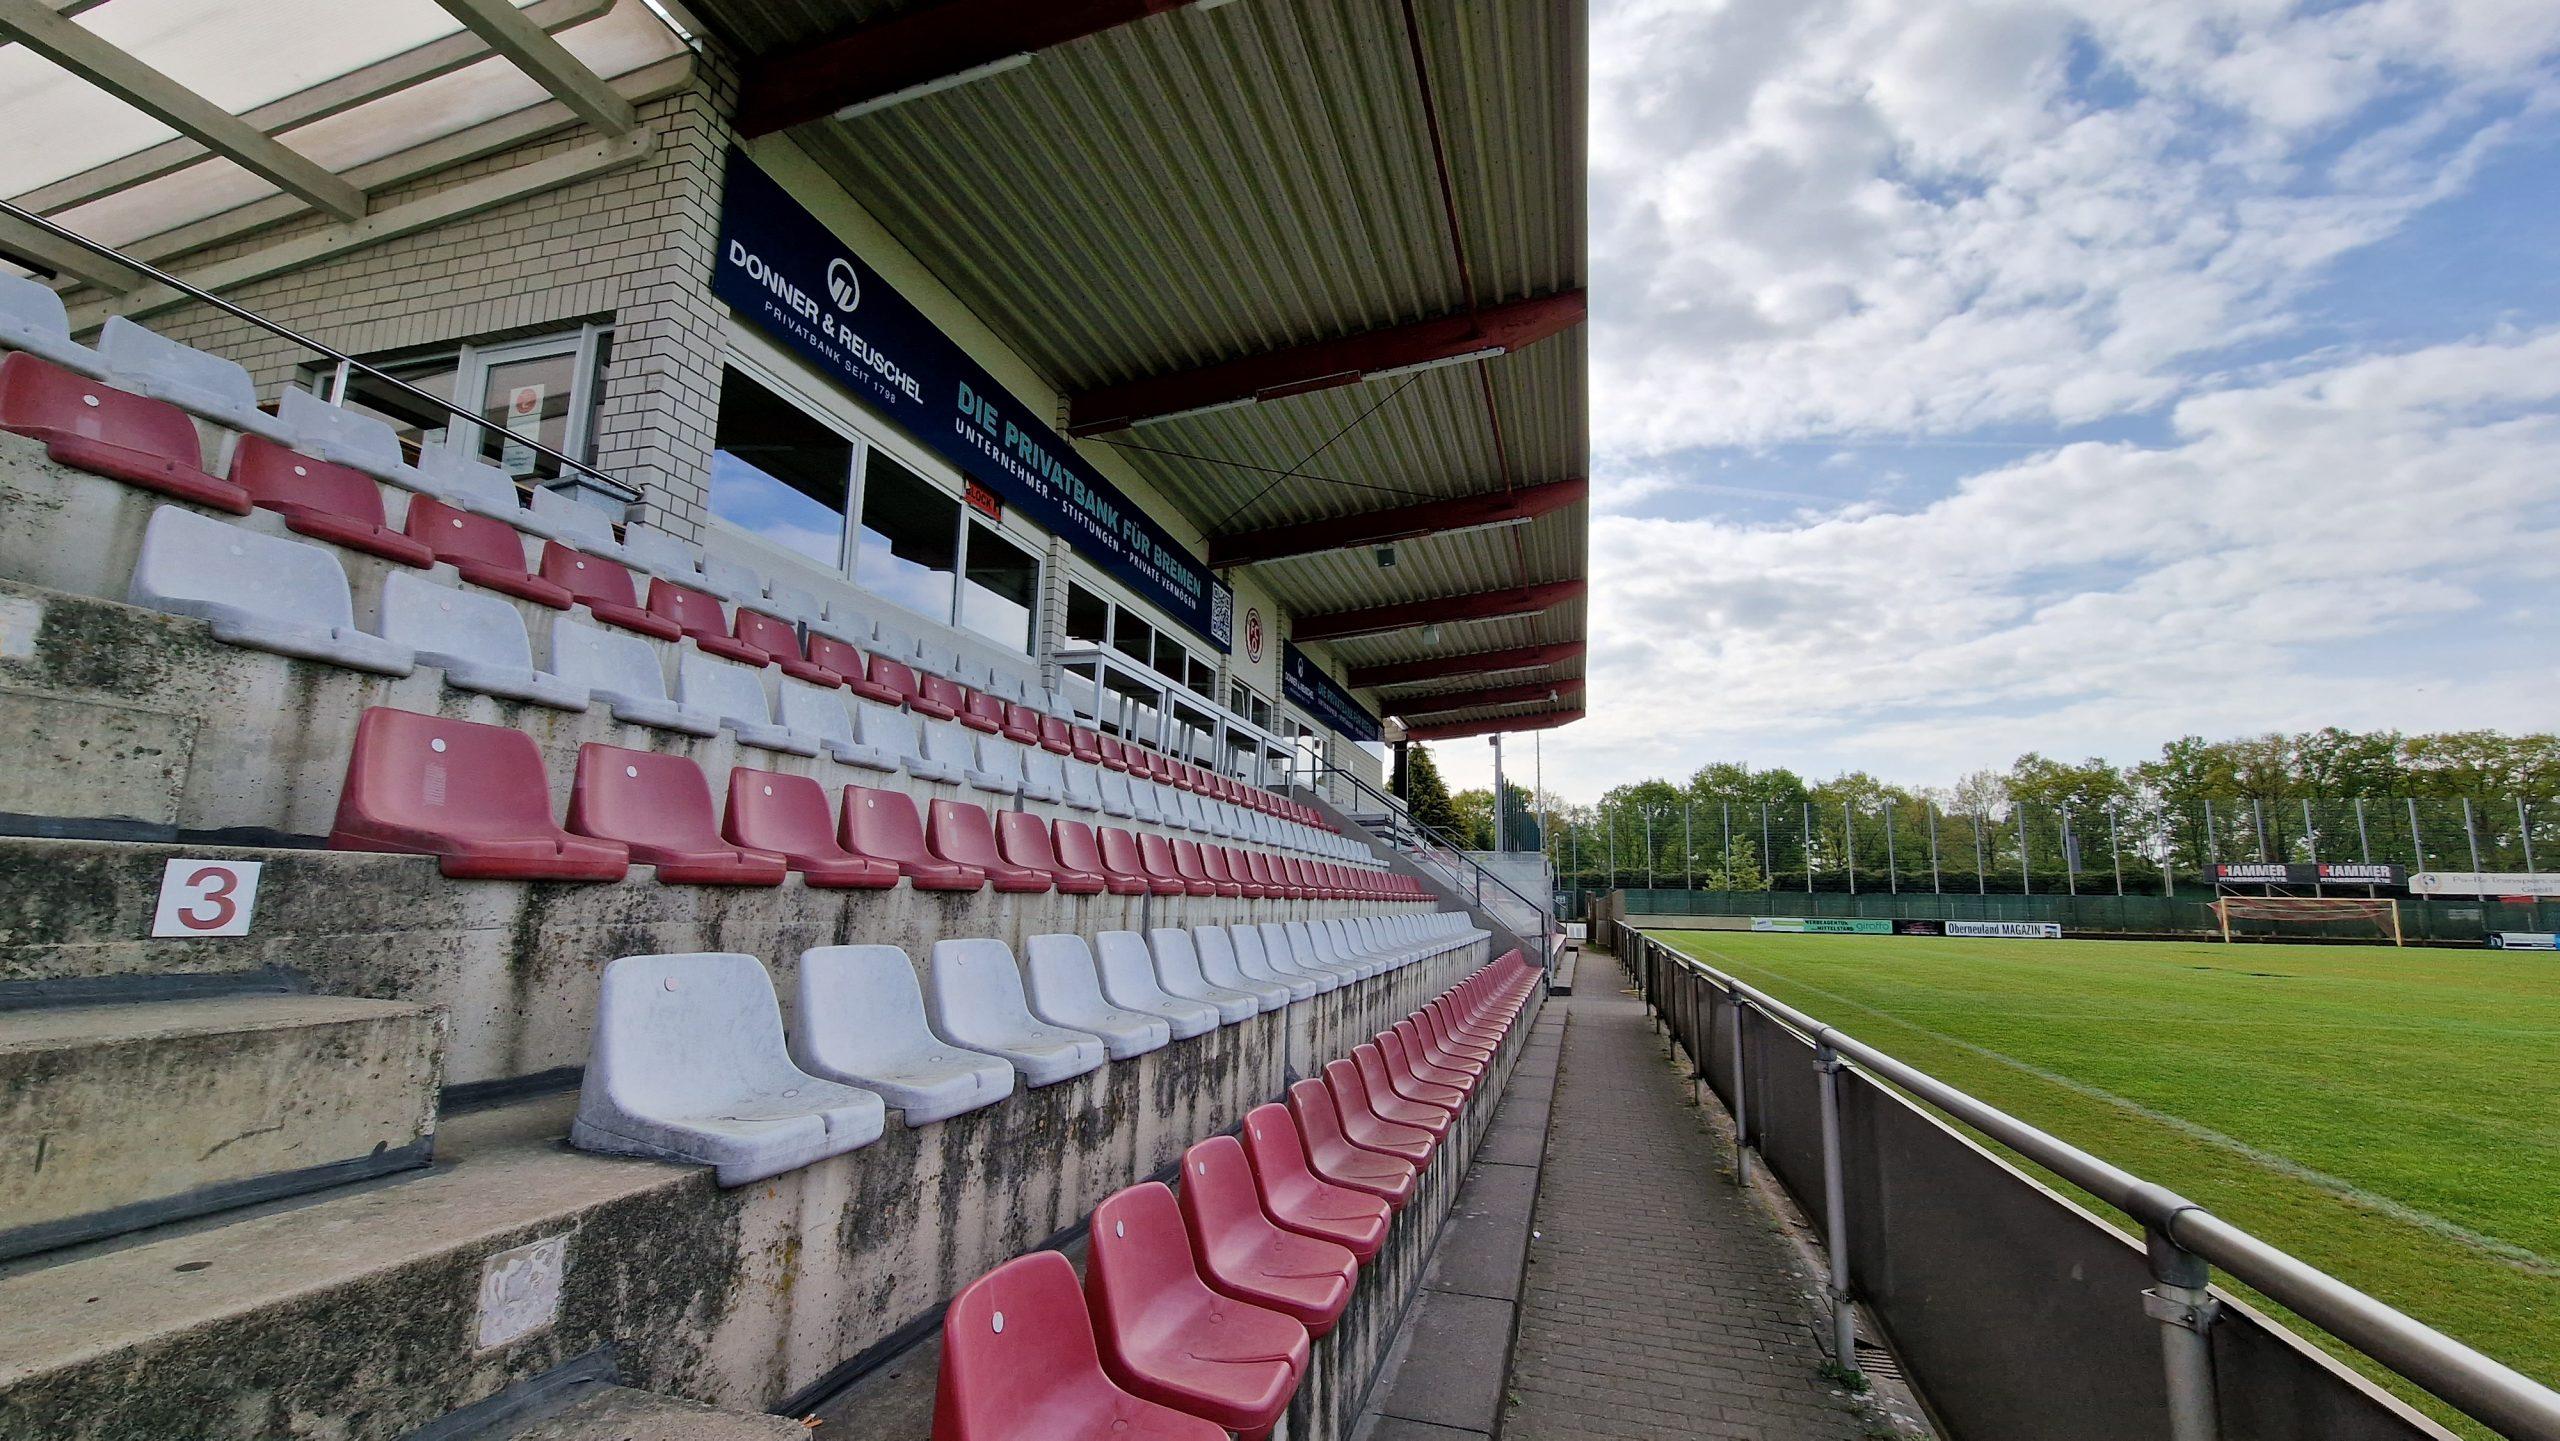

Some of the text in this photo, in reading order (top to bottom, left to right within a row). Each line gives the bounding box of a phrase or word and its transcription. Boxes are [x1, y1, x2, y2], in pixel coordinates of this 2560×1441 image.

[729, 239, 924, 405] DONNER & REUSCHEL
[764, 301, 896, 404] PRIVATBANK SEIT 1798
[955, 417, 1049, 499] UNTERNEHMER
[1062, 500, 1119, 552] STIFTUNGEN
[1129, 552, 1160, 583] PRIVATE
[1160, 576, 1197, 611] VERMÖGEN
[958, 380, 1201, 599] DIE PRIVATBANK FÜR BREMEN
[178, 866, 238, 930] 3
[2217, 864, 2286, 877] HAMMER
[2319, 864, 2391, 877] HAMMER
[1948, 923, 1999, 935] Oberneuland
[2002, 924, 2041, 936] MAGAZIN
